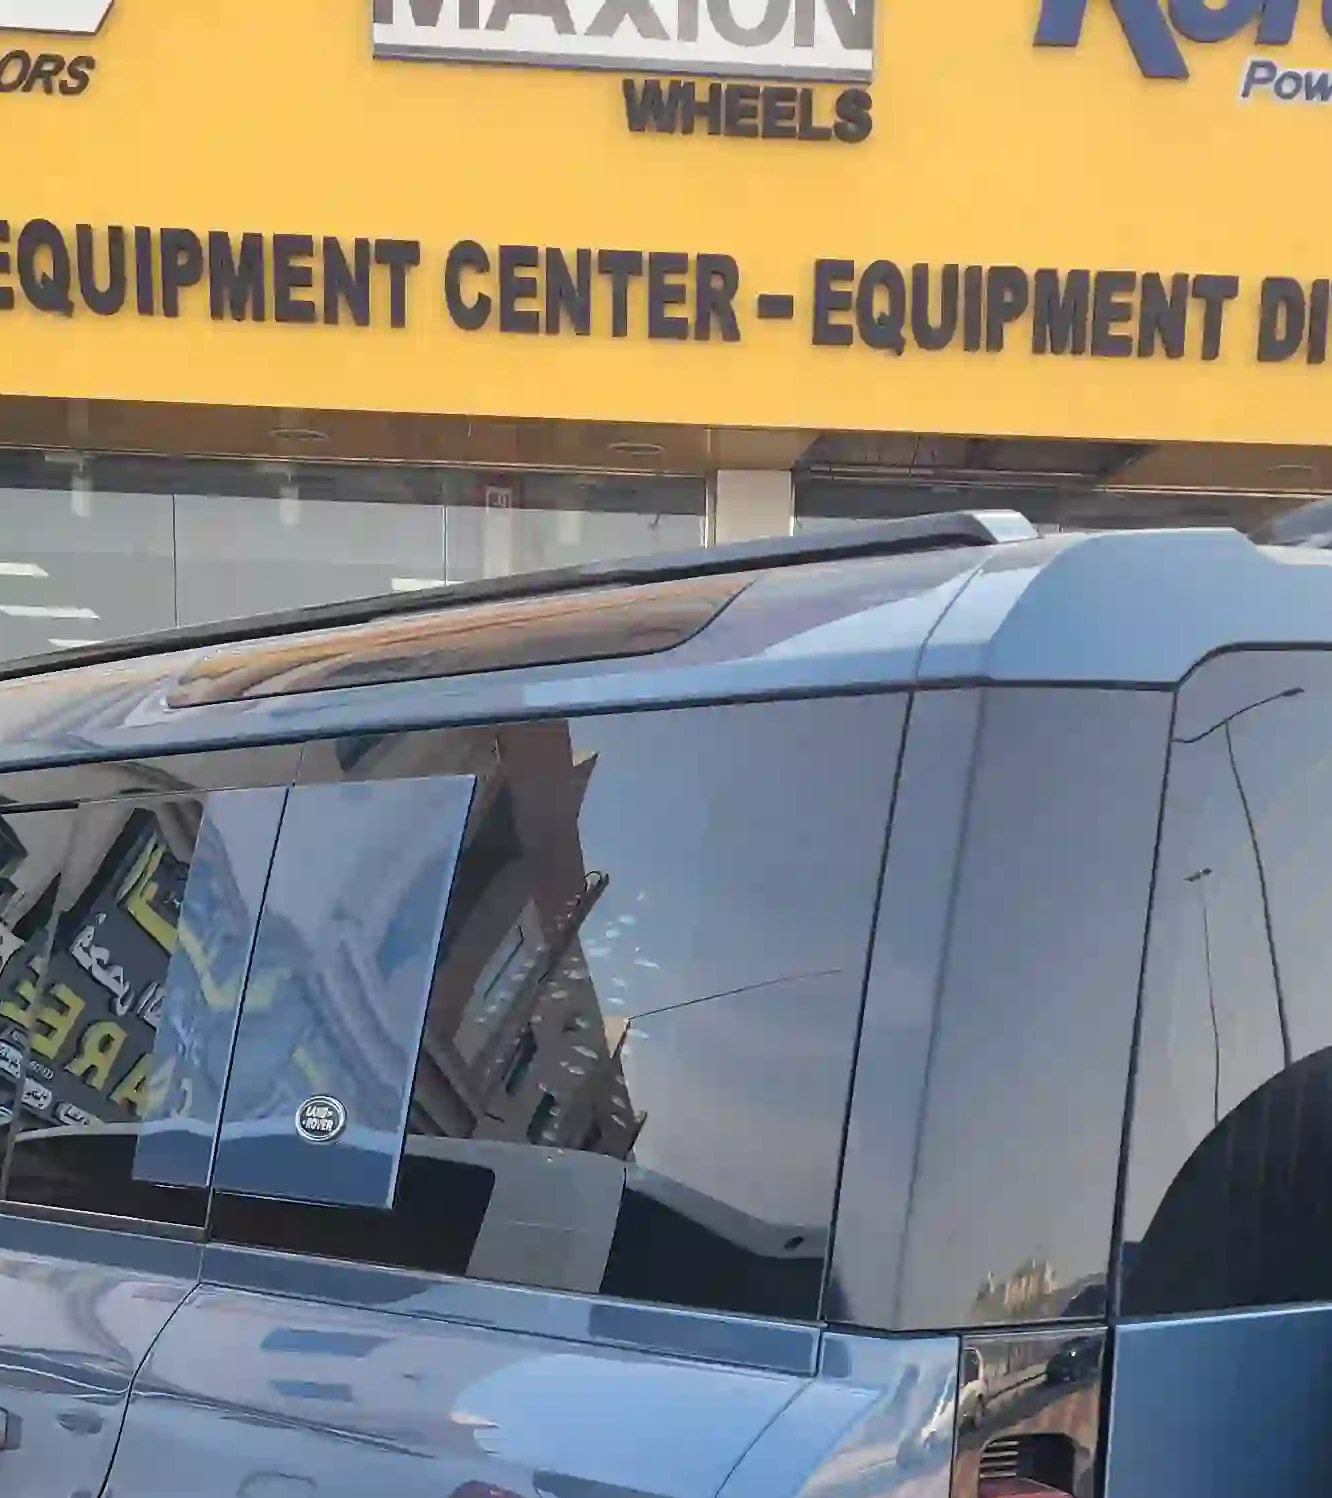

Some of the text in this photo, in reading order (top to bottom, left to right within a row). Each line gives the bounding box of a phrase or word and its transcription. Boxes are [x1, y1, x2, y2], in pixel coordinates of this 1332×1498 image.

[622, 79, 873, 143] WHEELS
[444, 240, 741, 342] CENTER
[812, 257, 1239, 362] EQUIPMENT
